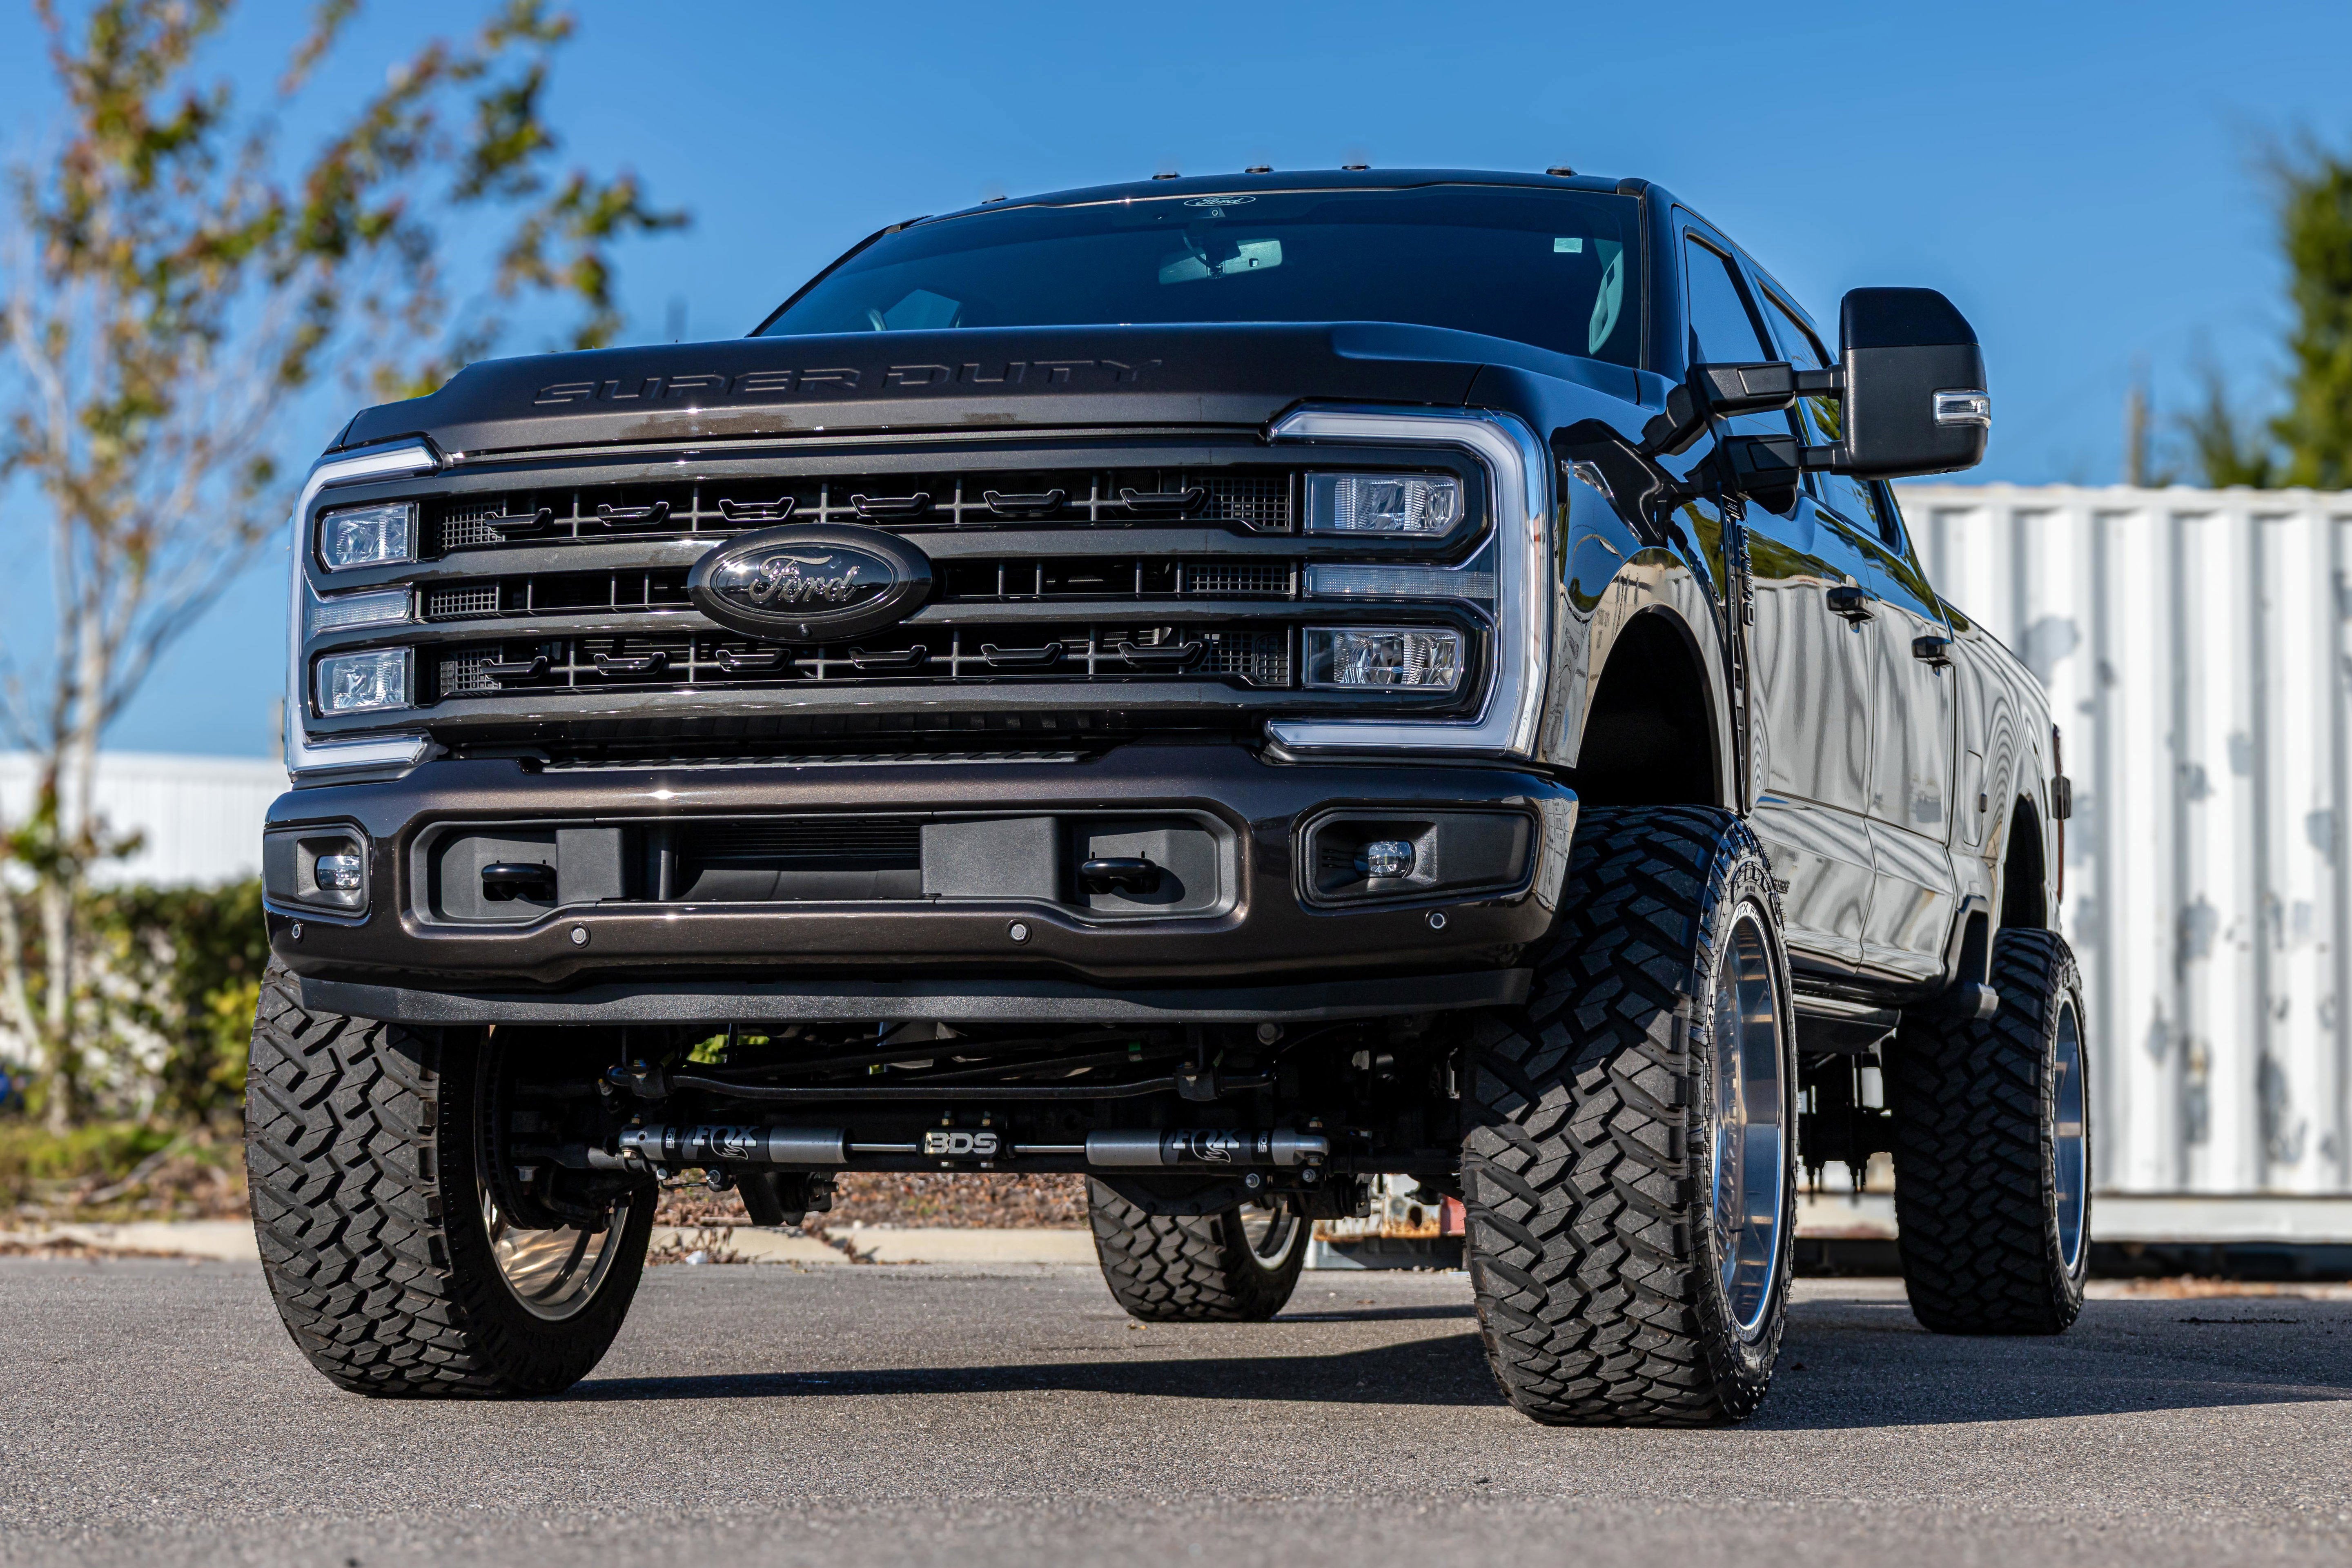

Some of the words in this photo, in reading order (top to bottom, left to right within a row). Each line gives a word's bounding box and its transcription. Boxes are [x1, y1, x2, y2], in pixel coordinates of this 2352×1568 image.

[1195, 196, 1245, 205] Ford
[533, 368, 862, 407] SUPER
[881, 359, 1163, 389] DUTY
[748, 555, 860, 603] Ford
[666, 1127, 674, 1149] BDS
[692, 1125, 760, 1160] FOX
[924, 1132, 997, 1154] BDS
[1173, 1127, 1241, 1163] FOX
